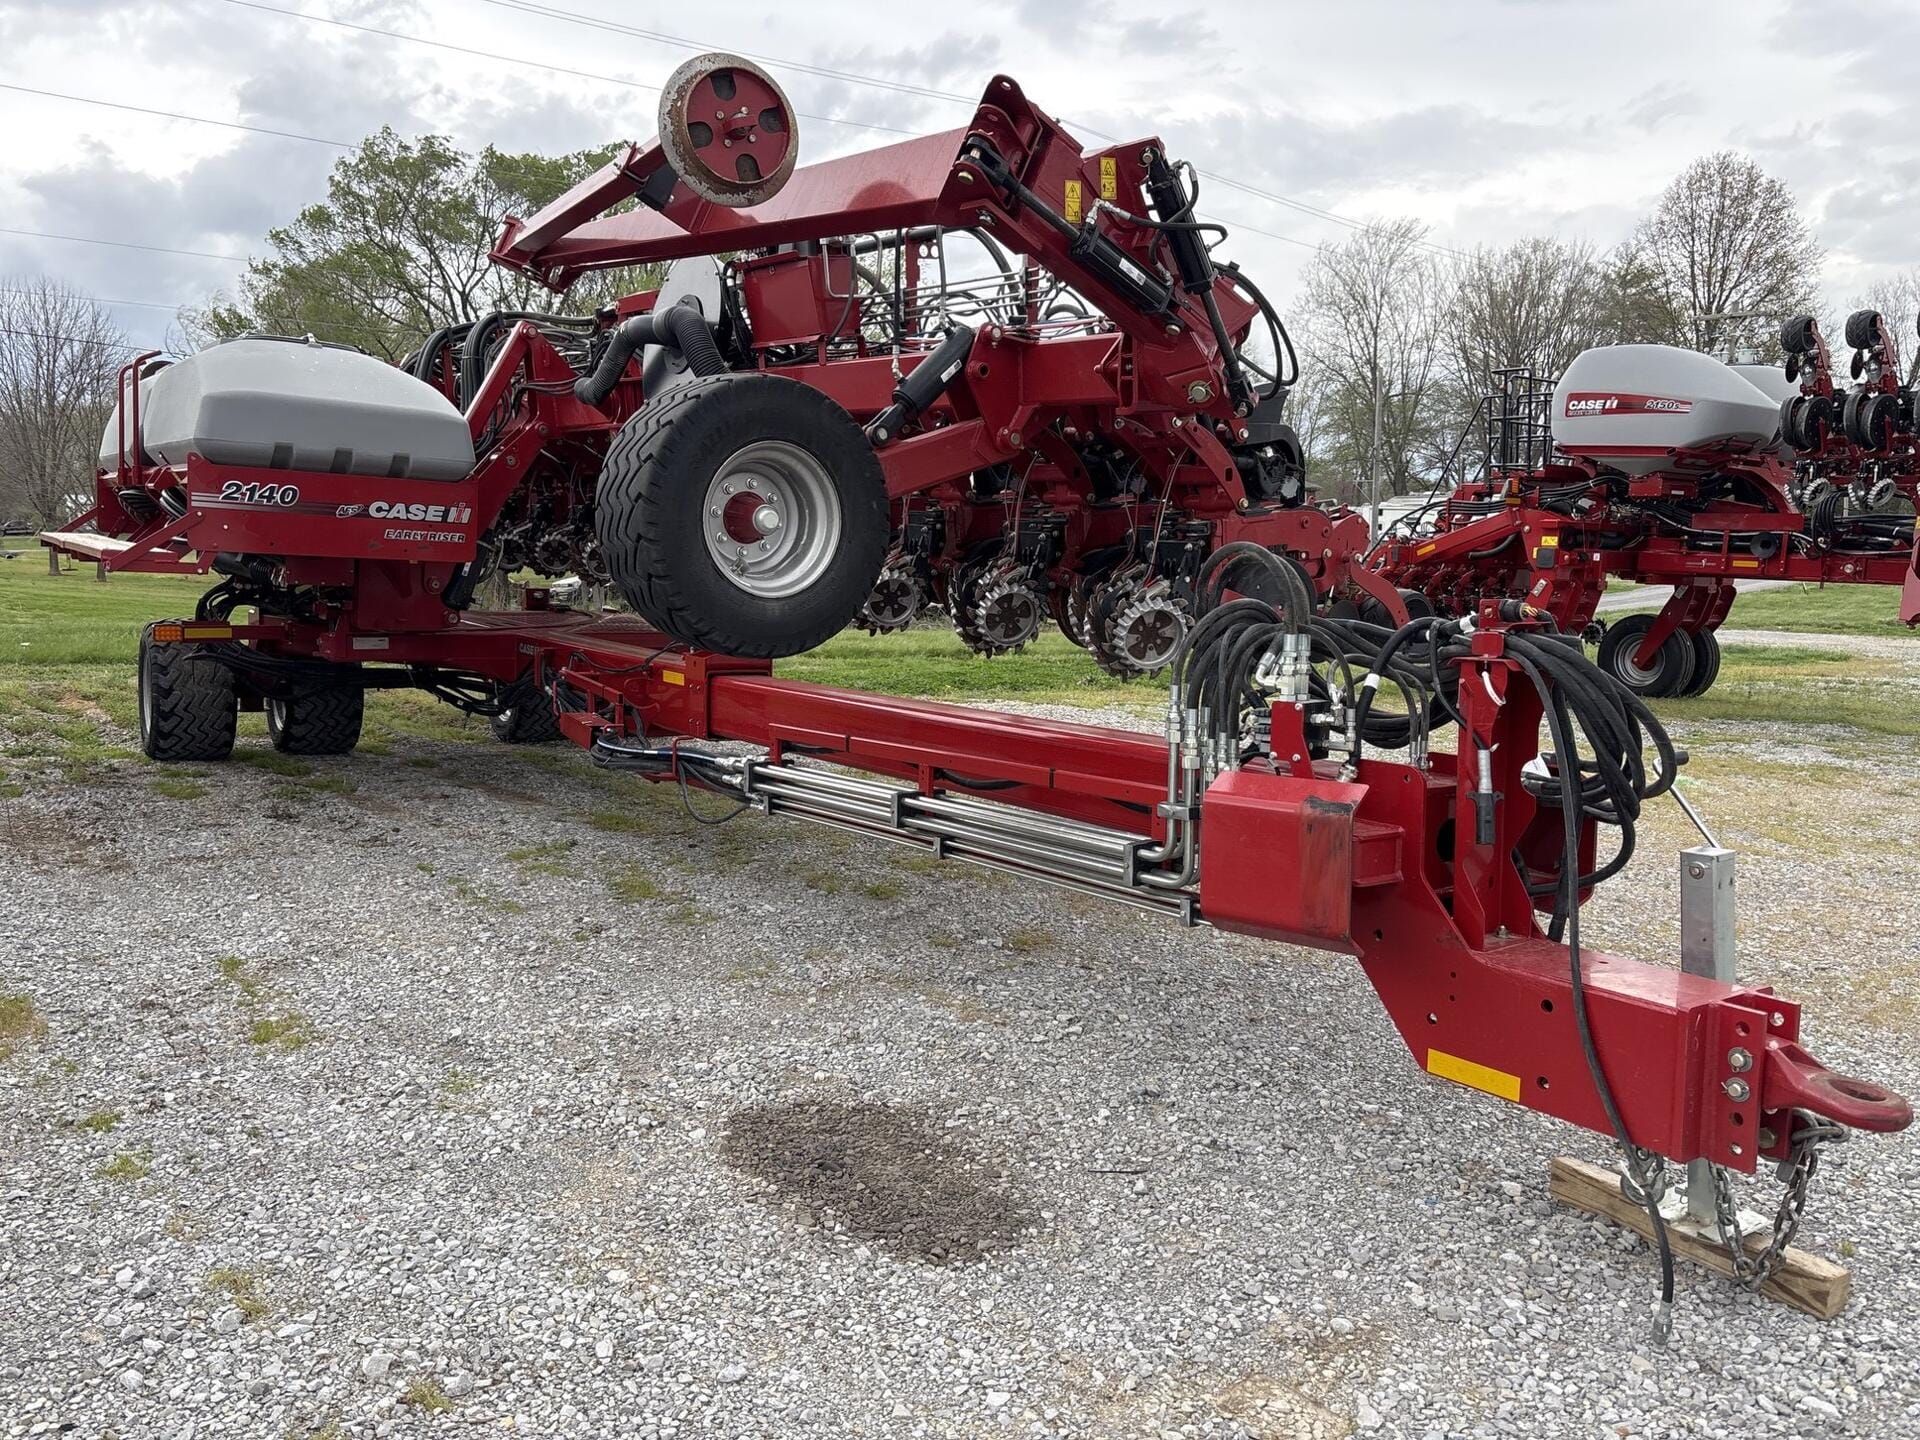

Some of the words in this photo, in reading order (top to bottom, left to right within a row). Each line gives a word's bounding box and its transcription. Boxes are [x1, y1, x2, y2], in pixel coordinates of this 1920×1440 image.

[1568, 399, 1605, 410] CASE
[220, 480, 300, 506] 2140
[368, 501, 445, 522] CASE
[384, 528, 427, 541] EARLY
[427, 531, 466, 543] RISER
